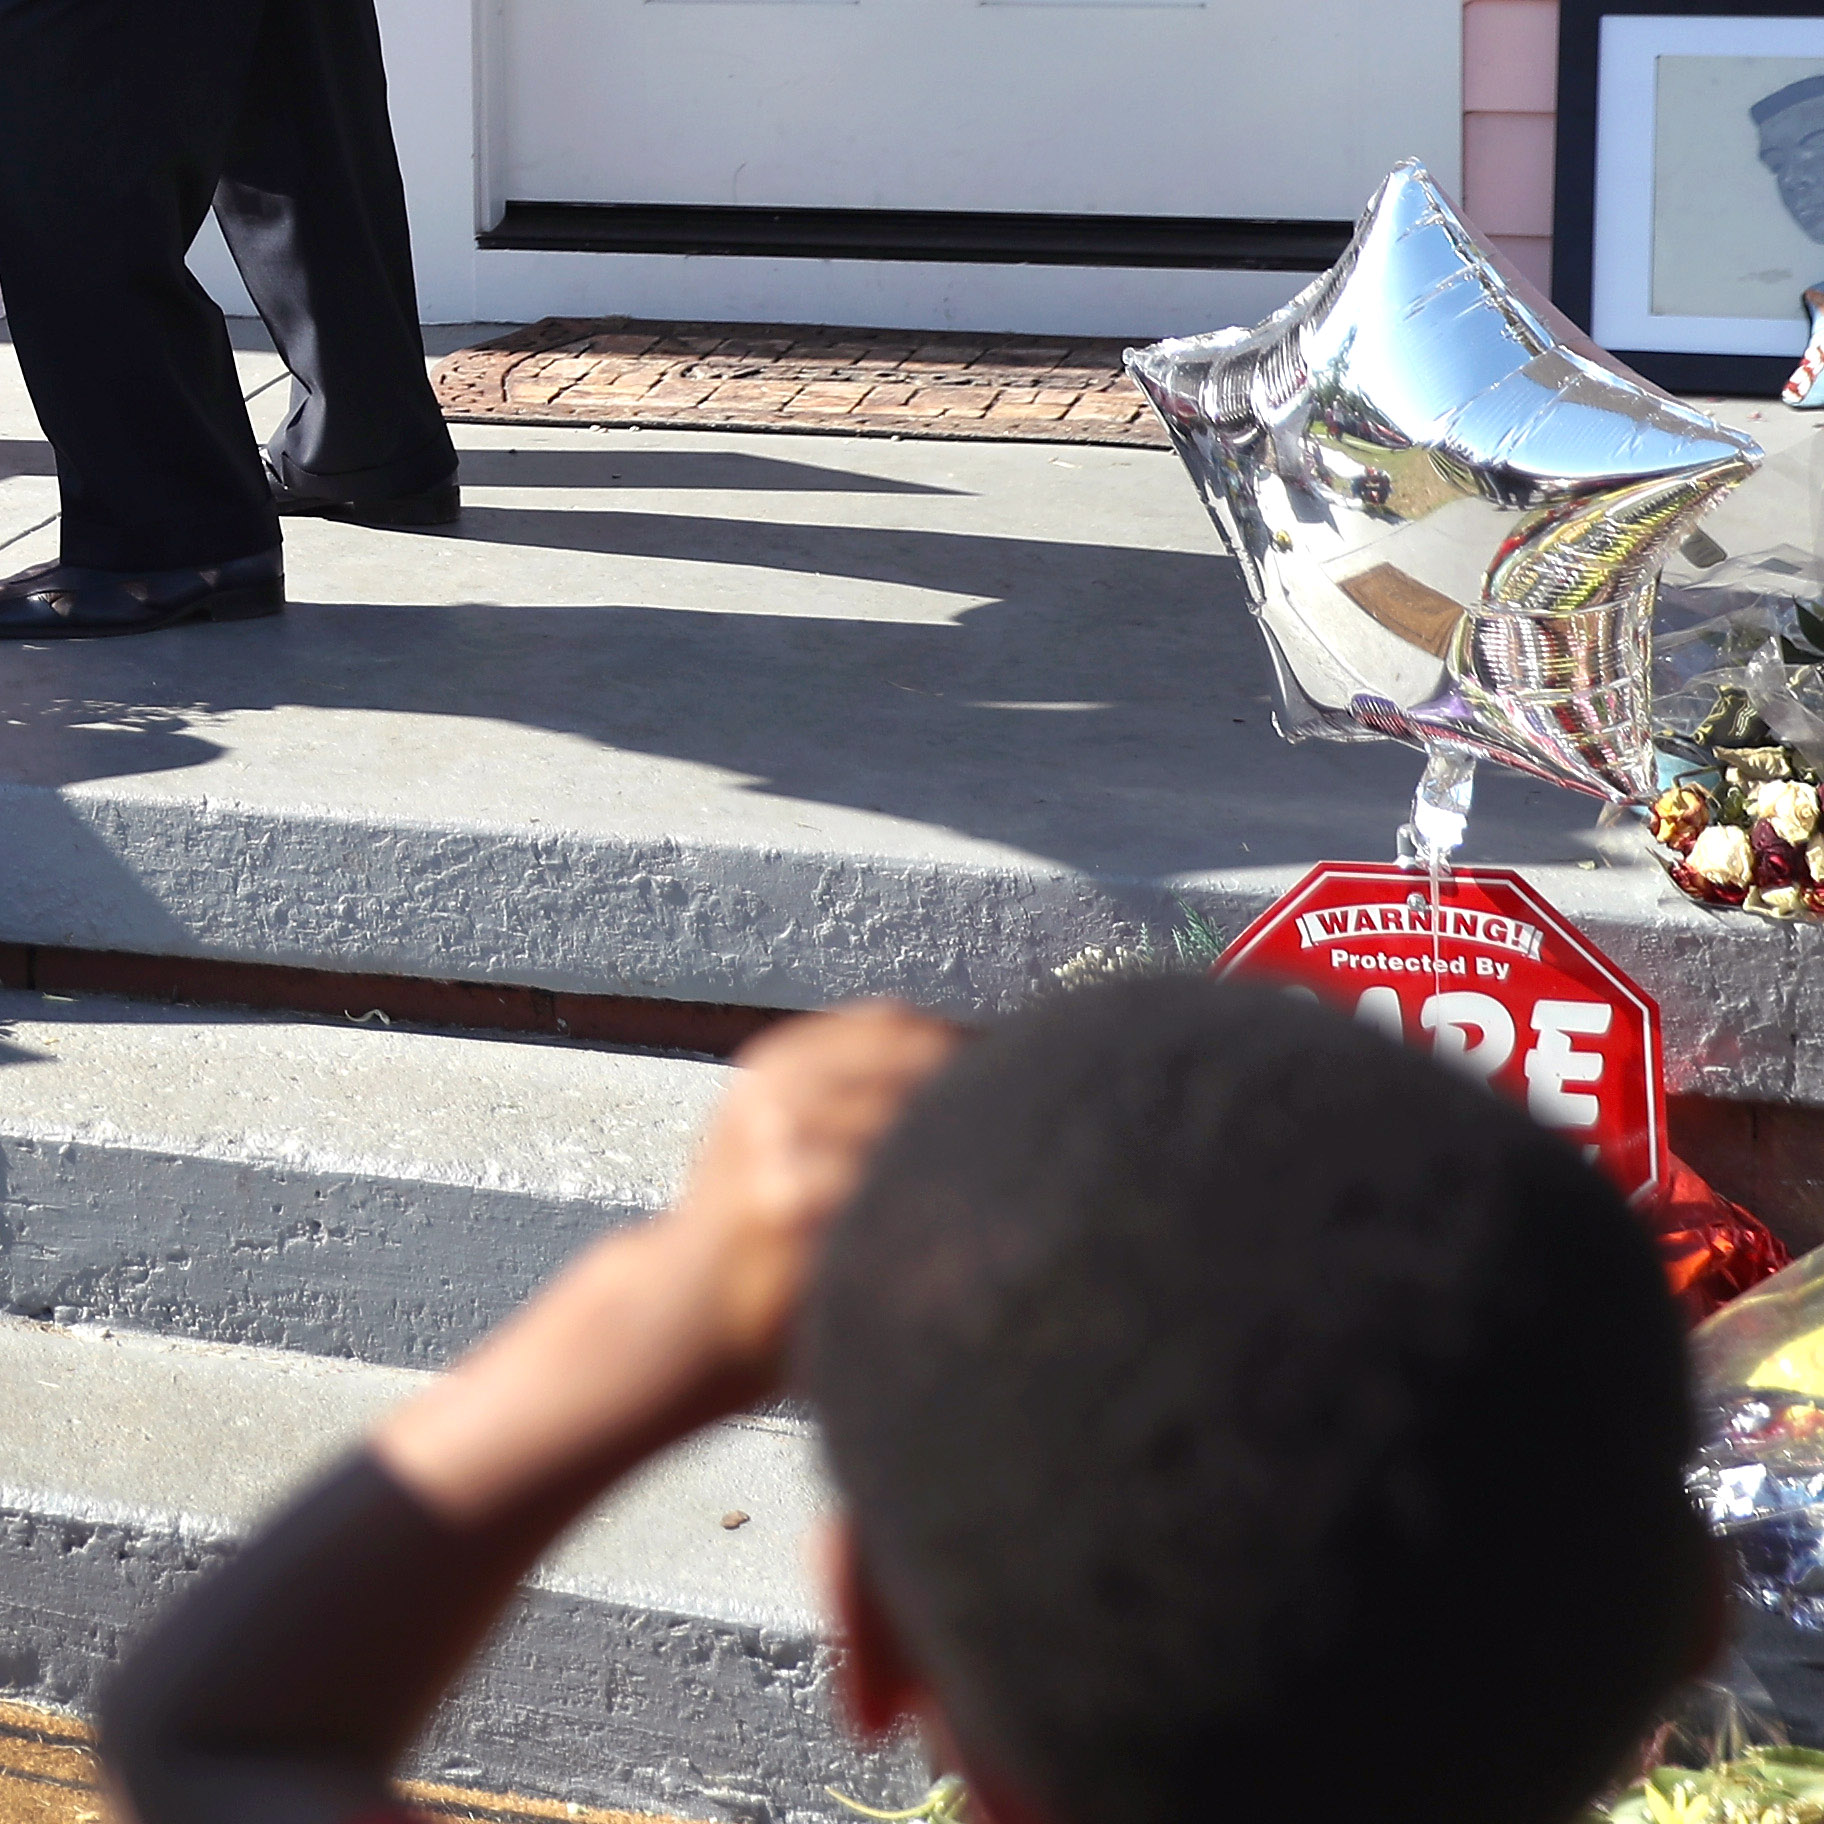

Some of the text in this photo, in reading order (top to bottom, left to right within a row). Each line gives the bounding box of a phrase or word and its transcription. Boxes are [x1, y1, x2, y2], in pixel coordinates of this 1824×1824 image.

[1315, 907, 1525, 950] WARNING!
[1330, 947, 1511, 981] Protected By
